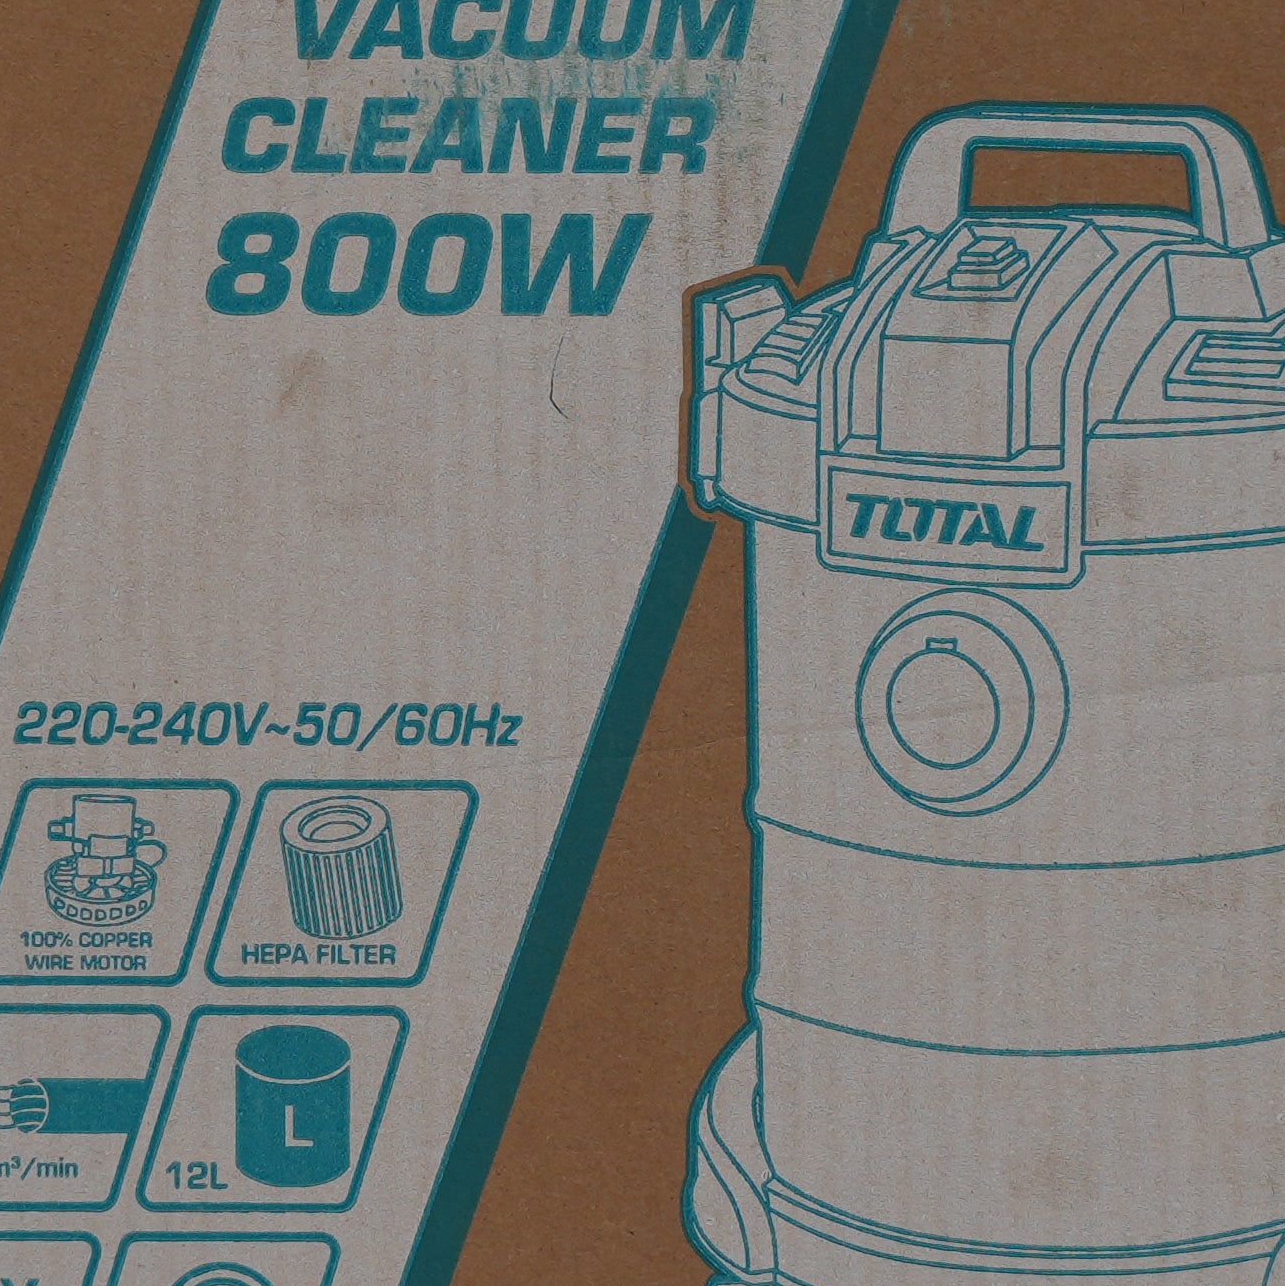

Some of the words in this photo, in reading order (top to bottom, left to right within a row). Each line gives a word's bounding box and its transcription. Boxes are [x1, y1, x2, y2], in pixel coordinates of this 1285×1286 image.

[221, 96, 717, 175] CLEANER
[206, 211, 652, 317] 800W
[845, 494, 1044, 552] TOTAL
[14, 700, 524, 752] 220-240V~50/60Hz
[20, 931, 74, 948] 100%
[78, 931, 154, 949] COPPER
[240, 943, 310, 965] HEPA
[316, 943, 398, 966] FILTER
[24, 953, 75, 971] WIRE
[80, 953, 148, 972] MOTOR
[285, 1104, 314, 1148] L
[165, 1160, 229, 1191] 12L
